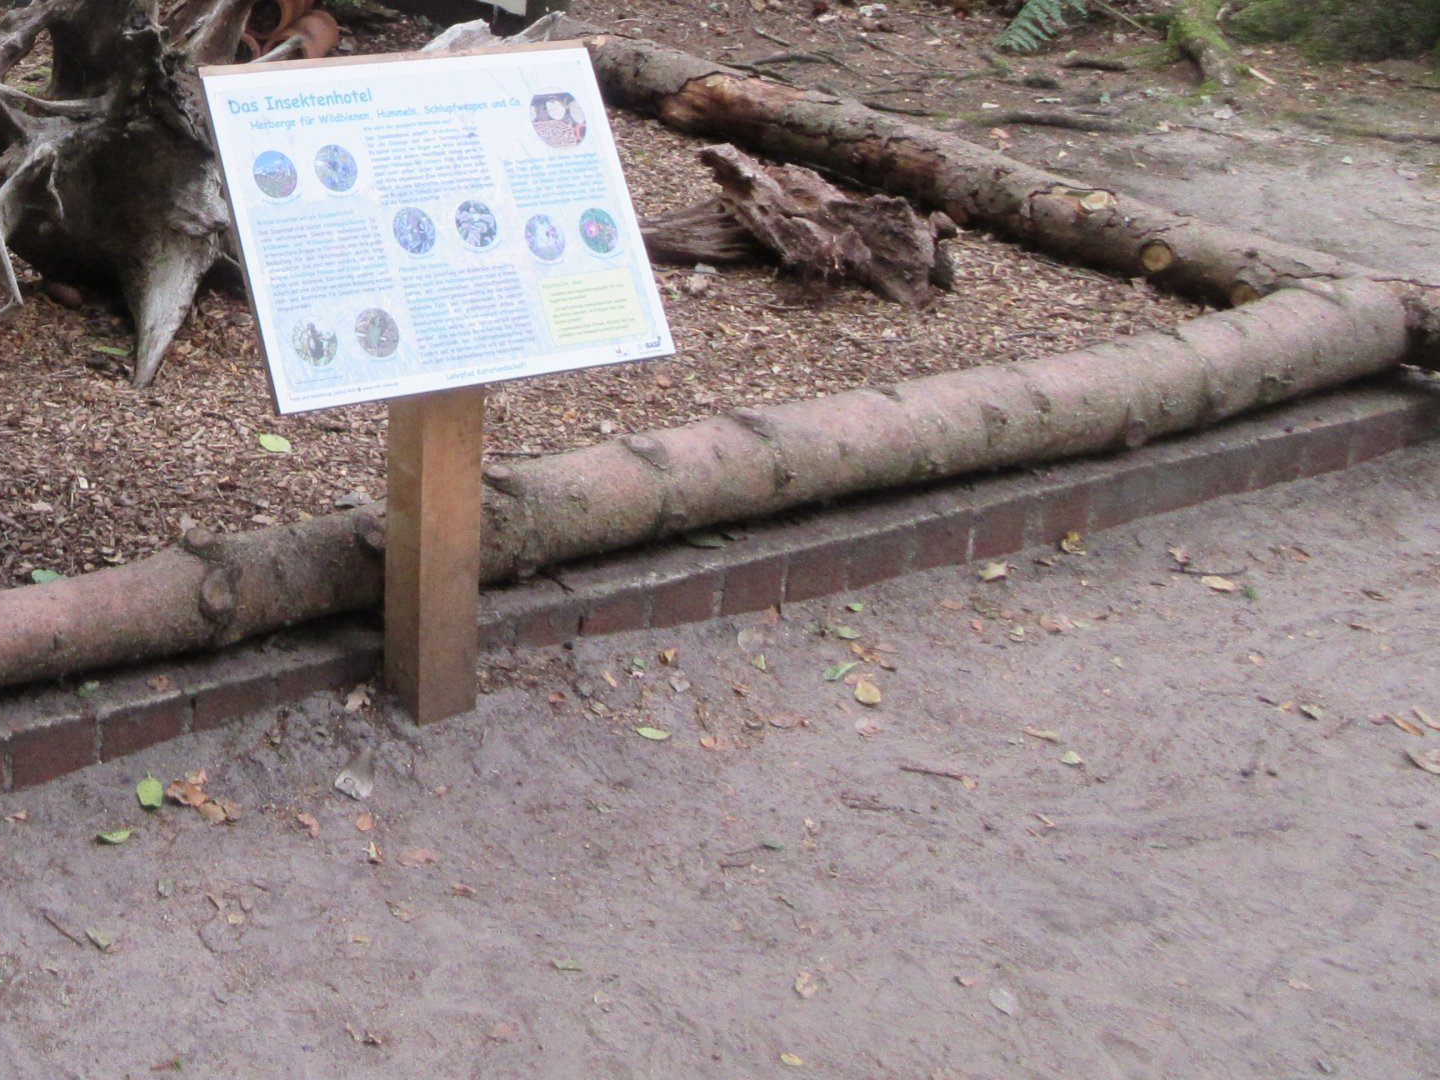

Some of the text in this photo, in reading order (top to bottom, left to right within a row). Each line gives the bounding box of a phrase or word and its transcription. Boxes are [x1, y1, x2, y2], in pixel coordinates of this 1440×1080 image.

[227, 87, 373, 115] Das Insektenhotel
[250, 118, 297, 130] Herberge
[300, 115, 315, 126] für
[319, 111, 373, 124] Wildbienen,
[377, 107, 420, 119] Hummeln,
[424, 100, 488, 115] Schlupfwespen
[491, 98, 506, 108] und
